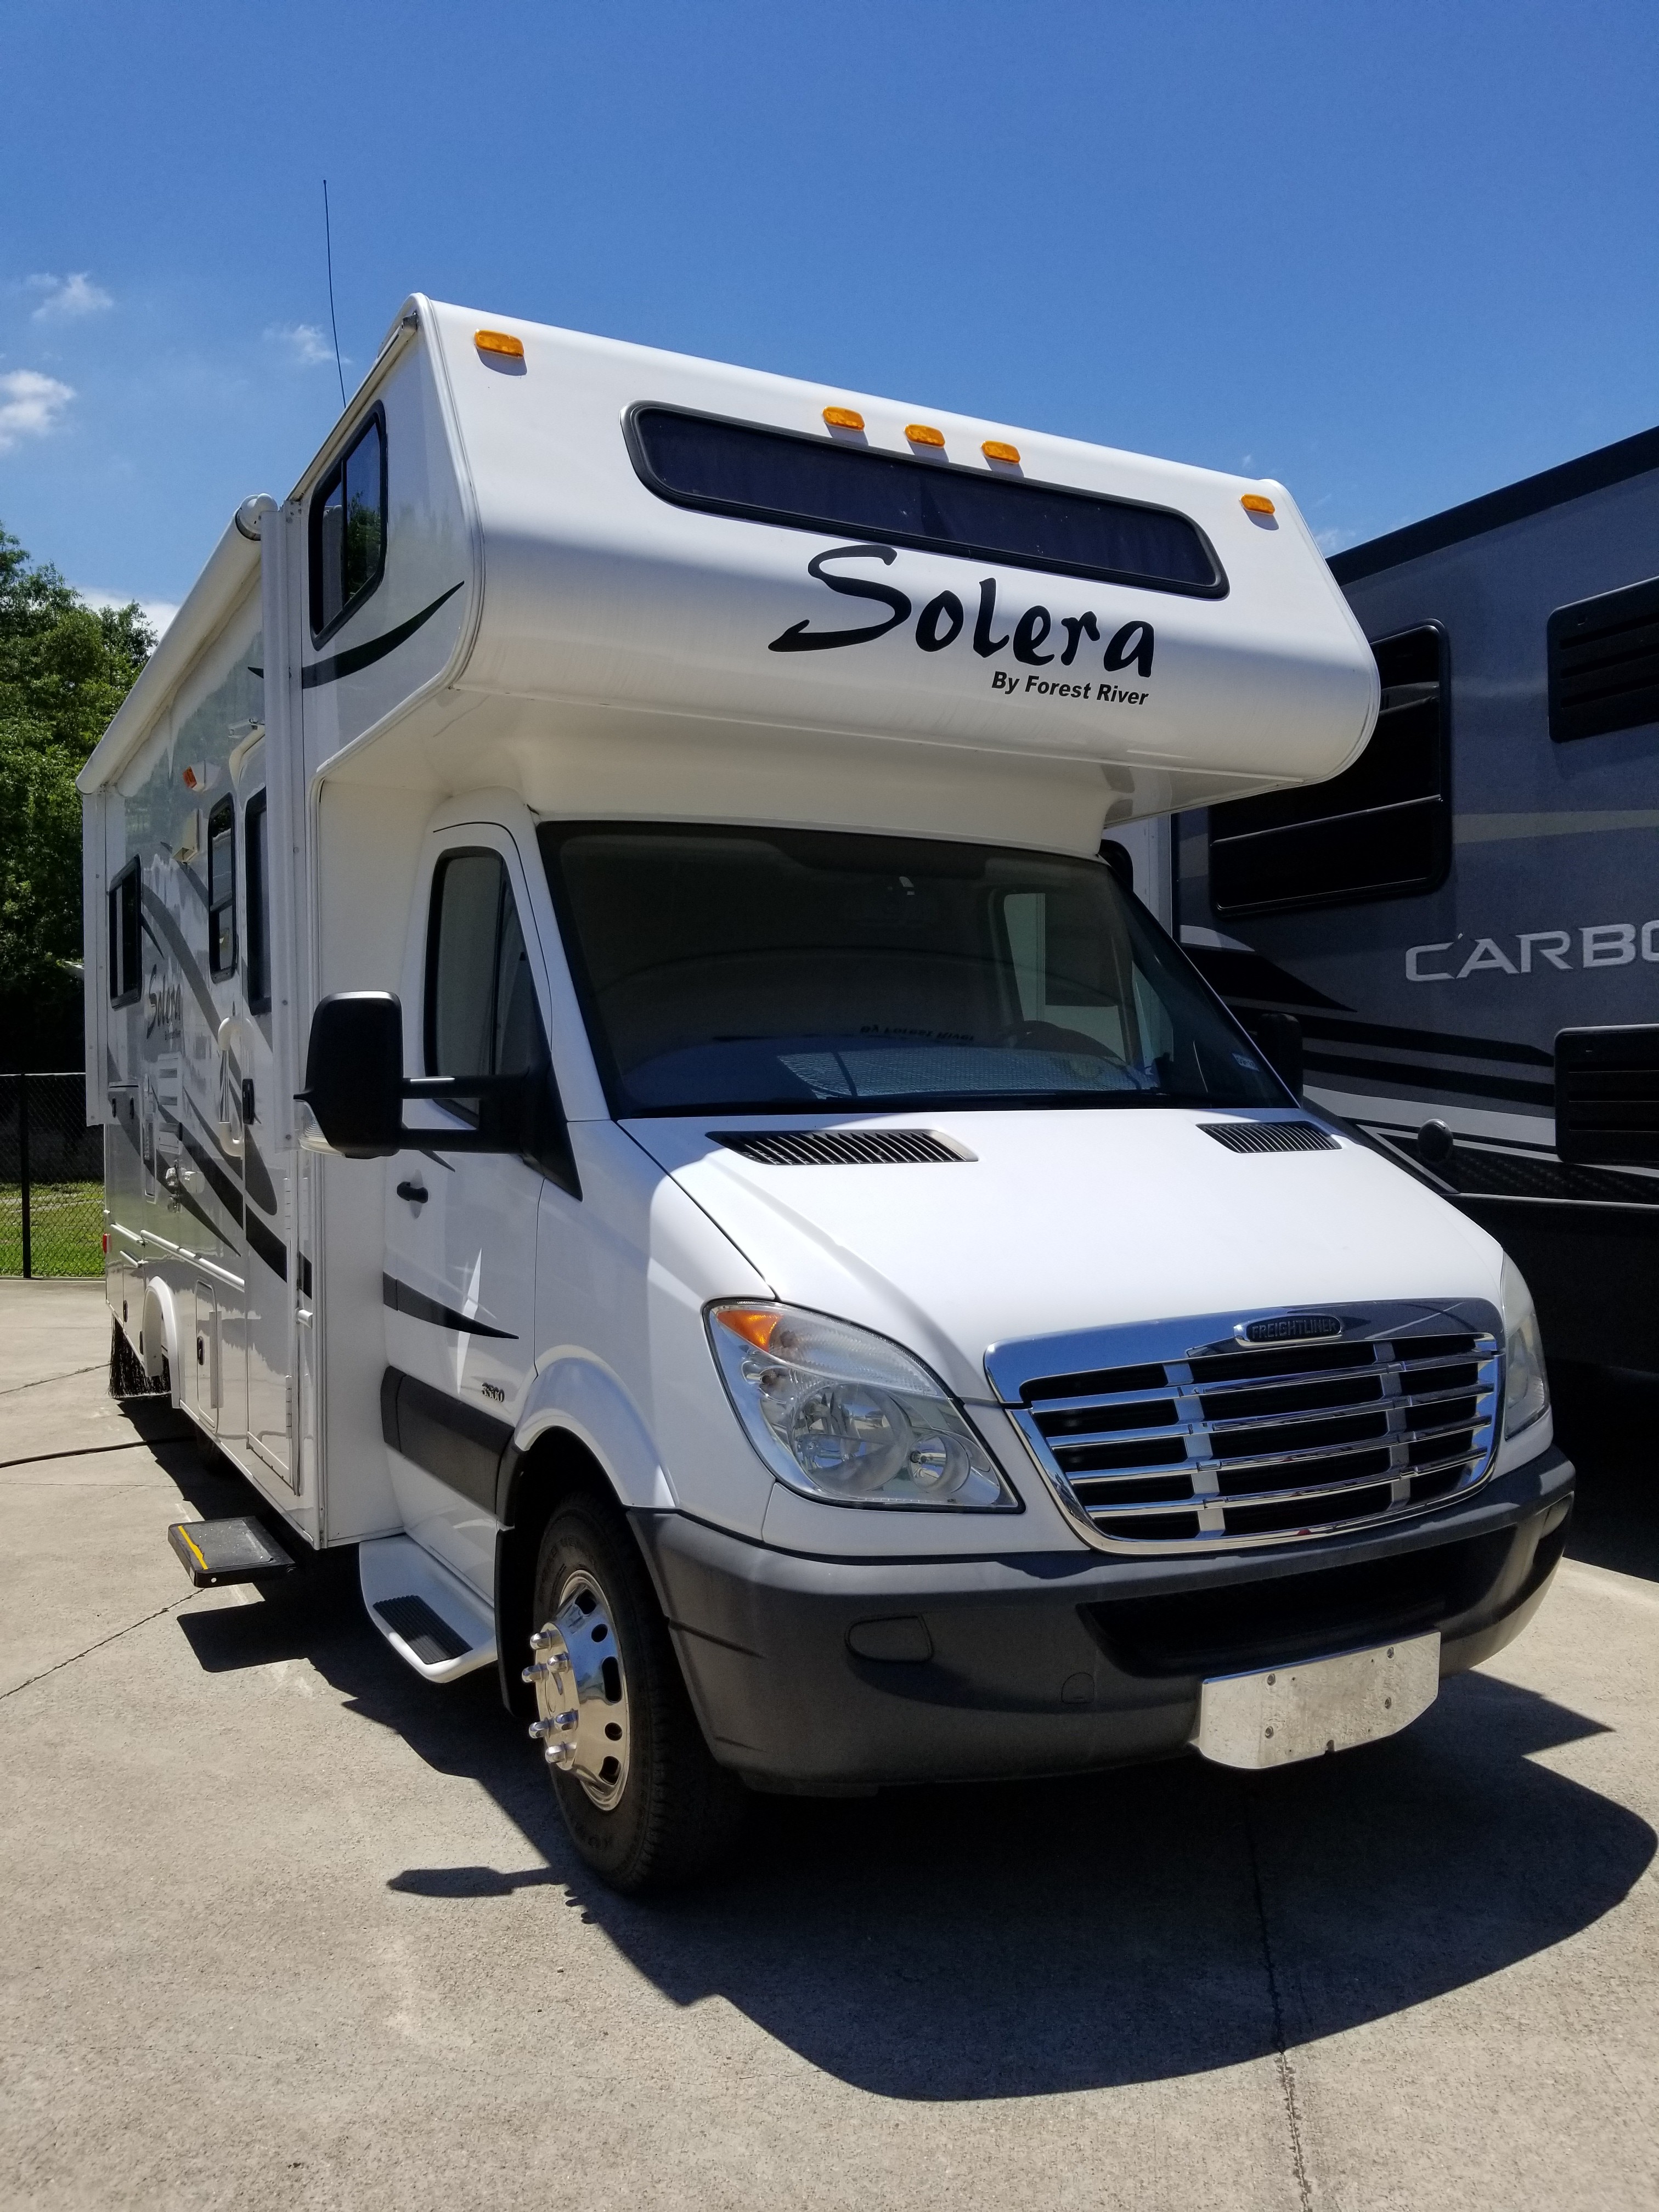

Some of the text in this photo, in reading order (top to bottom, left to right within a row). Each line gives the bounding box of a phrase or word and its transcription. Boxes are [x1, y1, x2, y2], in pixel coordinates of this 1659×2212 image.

[768, 544, 1154, 678] Solera
[991, 671, 1149, 705] By Forest River
[1252, 1319, 1337, 1339] FREIGHTLINER
